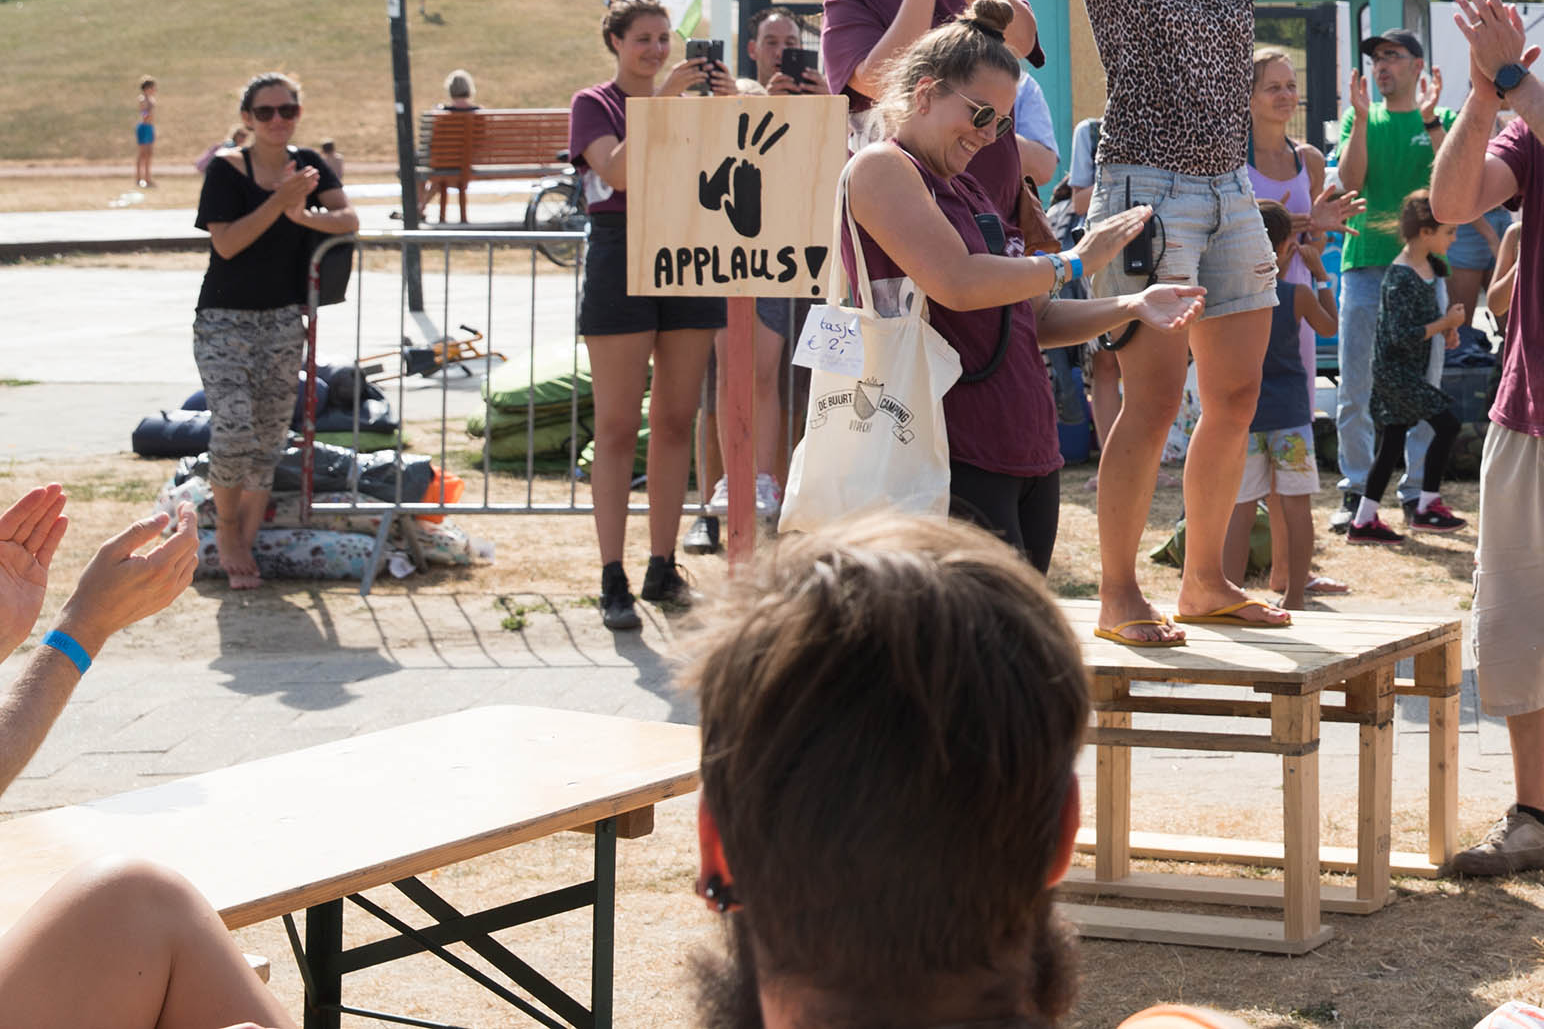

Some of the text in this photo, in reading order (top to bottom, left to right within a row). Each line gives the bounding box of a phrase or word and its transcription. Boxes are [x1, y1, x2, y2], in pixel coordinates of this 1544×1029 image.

[654, 245, 829, 295] APPLAUS!
[818, 393, 910, 423] DE BUURT CAMPING
